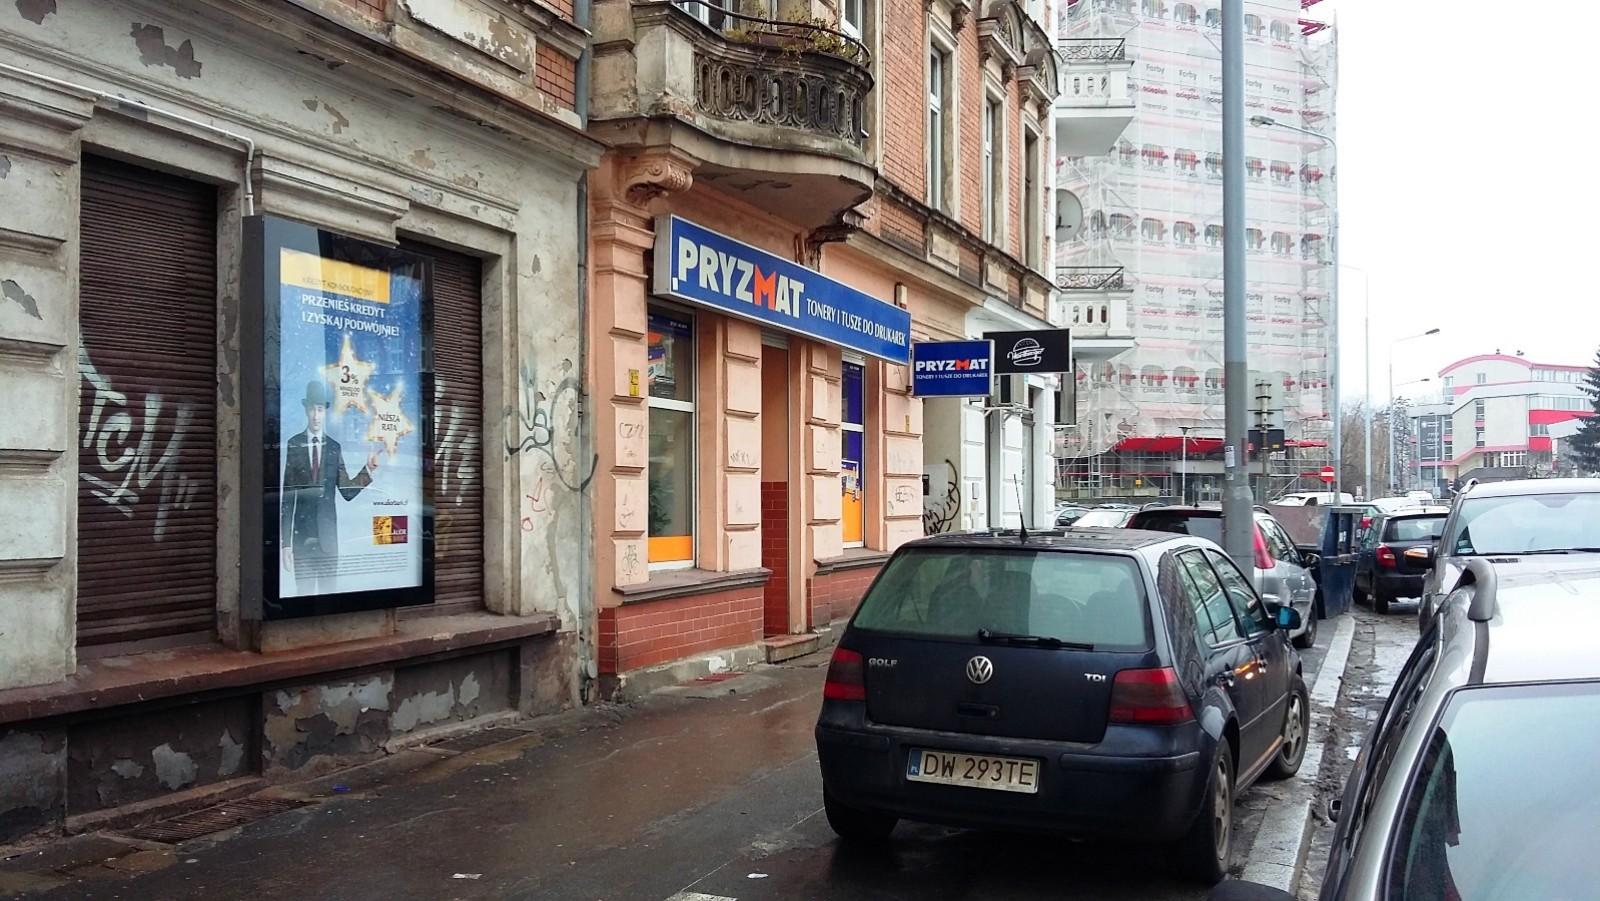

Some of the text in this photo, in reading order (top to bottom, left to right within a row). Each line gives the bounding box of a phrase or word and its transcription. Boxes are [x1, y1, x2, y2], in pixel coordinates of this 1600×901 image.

[678, 236, 906, 347] PRYZMAT TONERY I TUSZE DO DRUKAREK
[302, 294, 386, 318] PRZENIEŚ KREDYT
[302, 312, 400, 336] I ZYSKAJ PODWÓJNIE!
[341, 365, 359, 385] 3%
[915, 358, 989, 372] PRYZMAT
[382, 423, 398, 432] RATA
[868, 656, 897, 668] GOLF
[1084, 672, 1107, 683] TDI
[923, 754, 956, 777] DW
[963, 757, 1034, 786] 293TE
